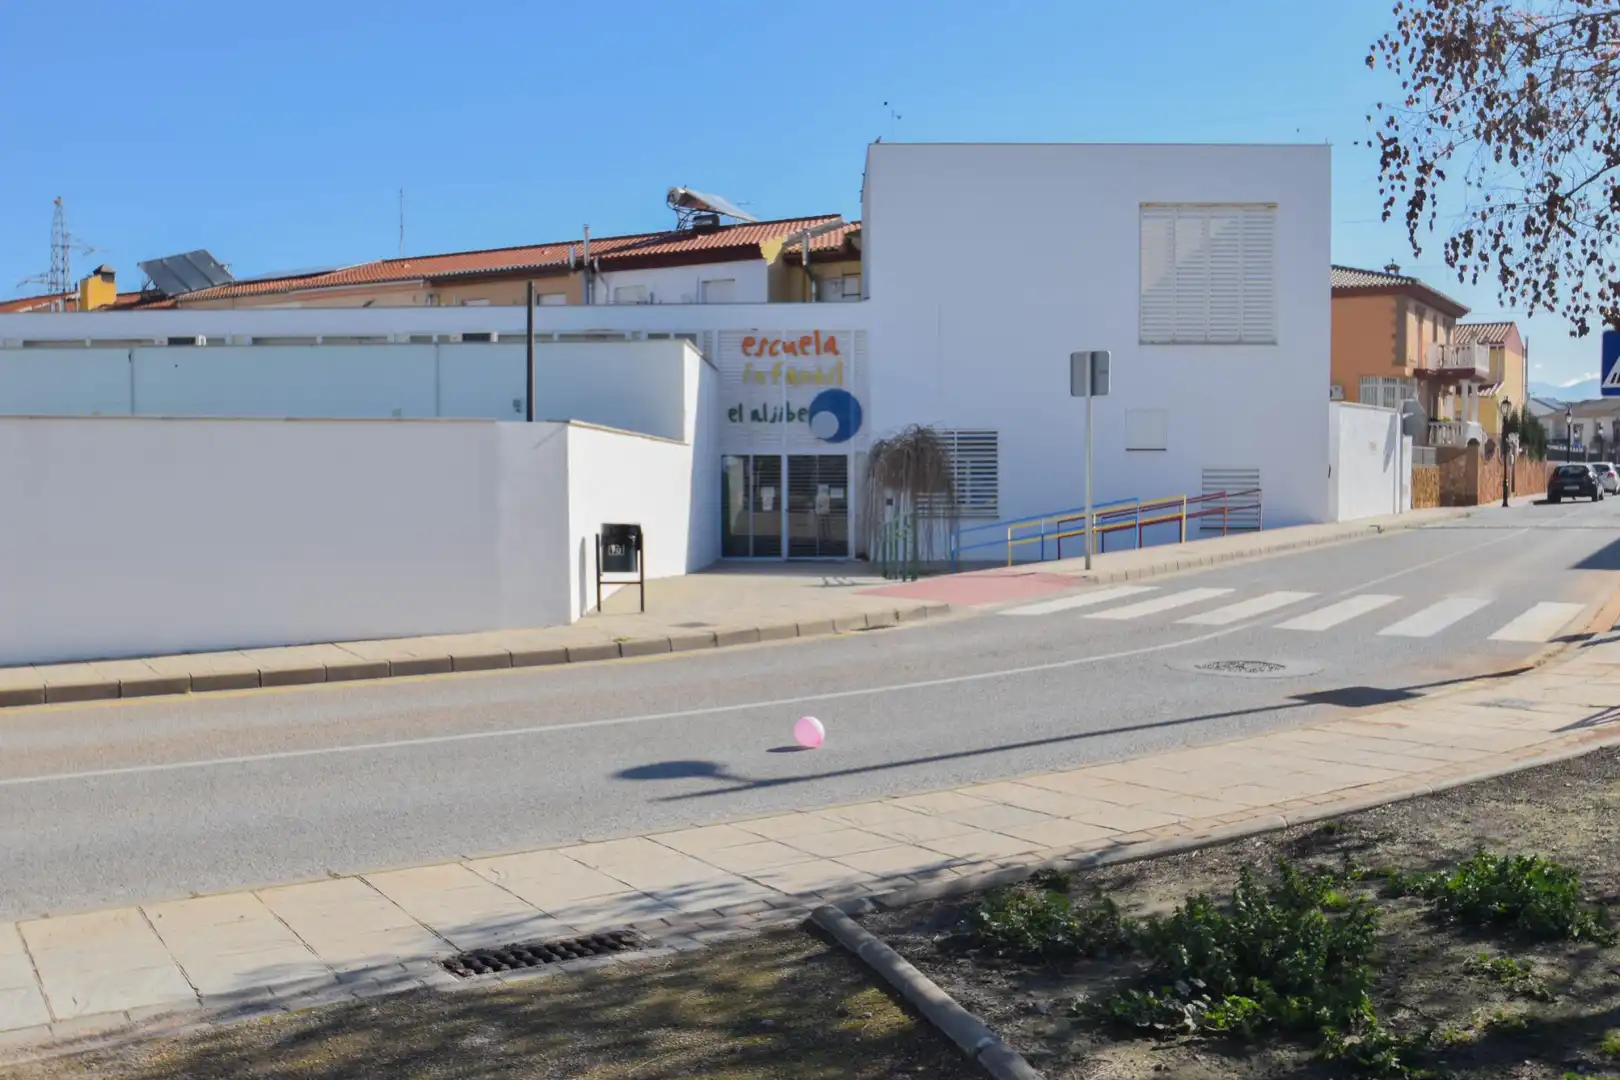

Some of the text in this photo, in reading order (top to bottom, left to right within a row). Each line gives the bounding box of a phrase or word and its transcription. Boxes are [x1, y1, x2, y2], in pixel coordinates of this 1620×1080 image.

[741, 329, 840, 357] escuela
[728, 401, 809, 423] el aljibe
